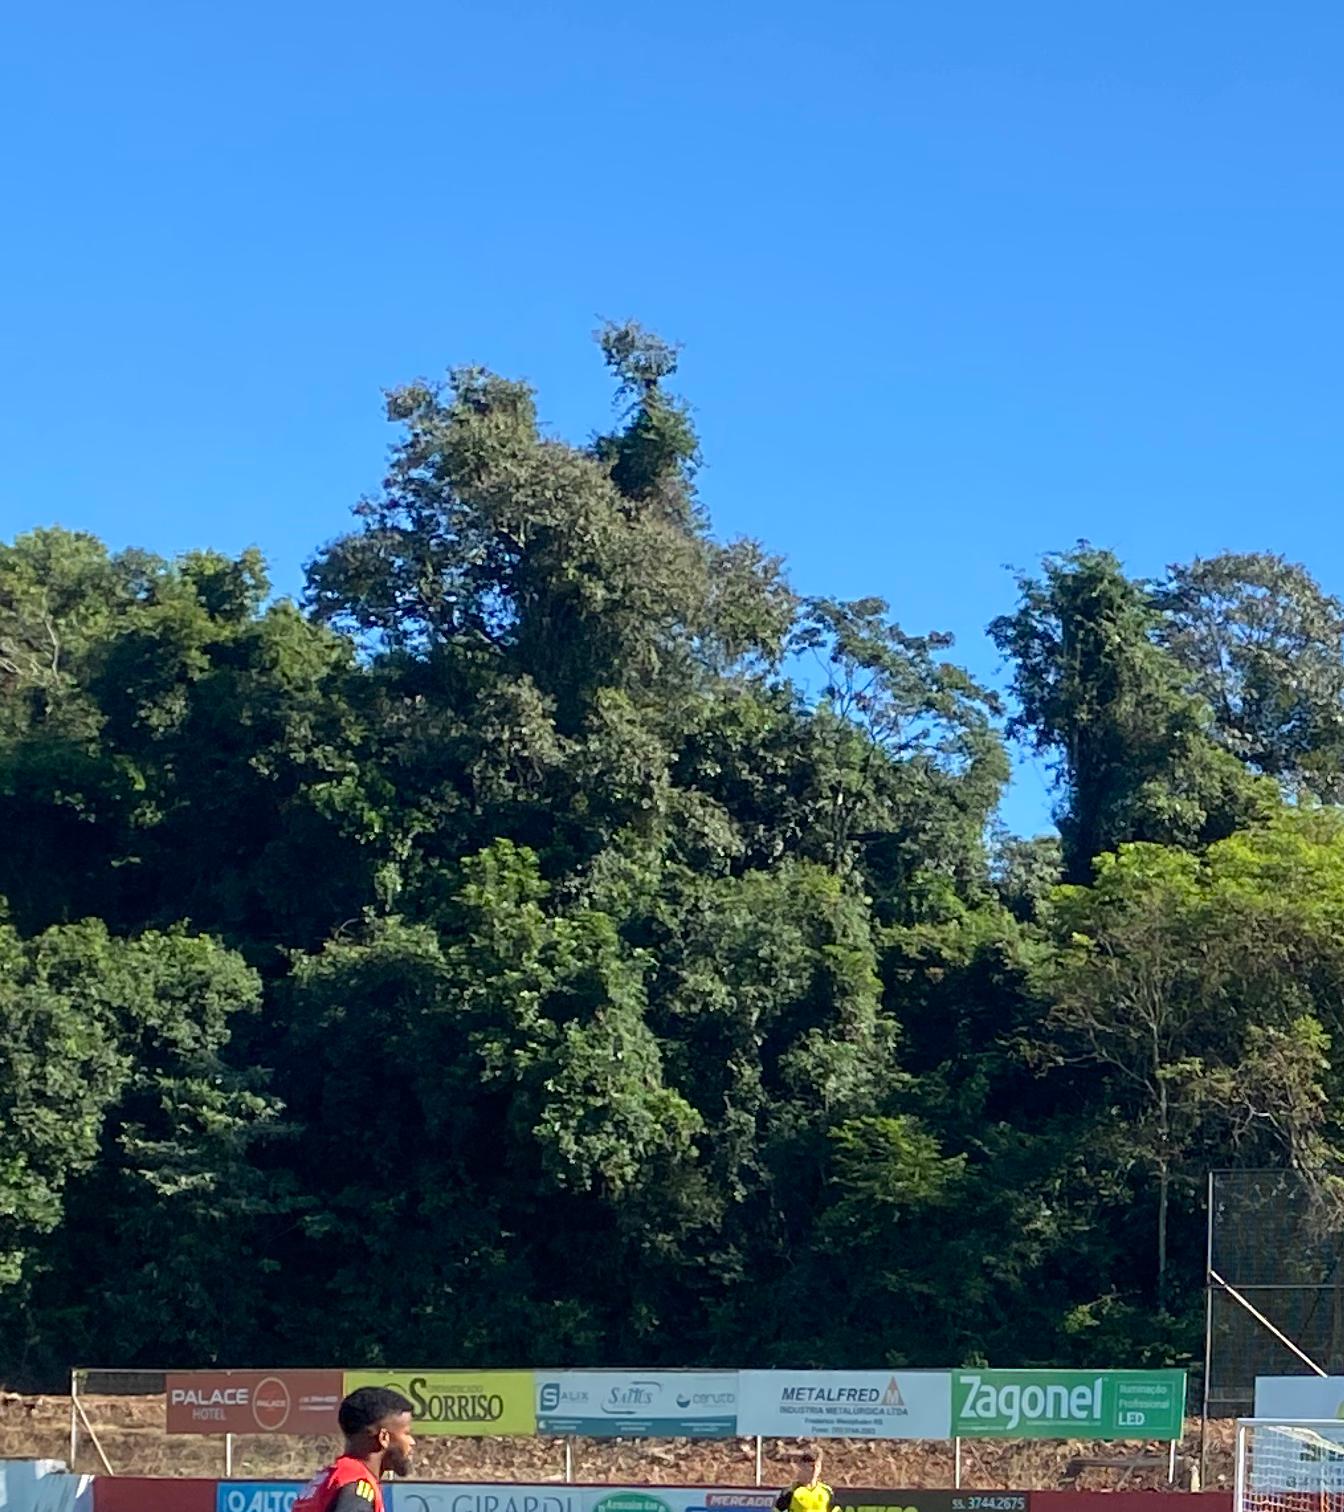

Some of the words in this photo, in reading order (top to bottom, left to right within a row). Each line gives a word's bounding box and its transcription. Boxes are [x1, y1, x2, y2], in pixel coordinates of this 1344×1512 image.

[172, 1388, 249, 1405] PALACE
[409, 1378, 503, 1421] SORRISO
[781, 1387, 880, 1402] METALFRED
[960, 1376, 1103, 1430] Zagonel
[192, 1407, 227, 1421] HOTEL
[1118, 1411, 1145, 1426] LED
[711, 1495, 774, 1507] MERCADO
